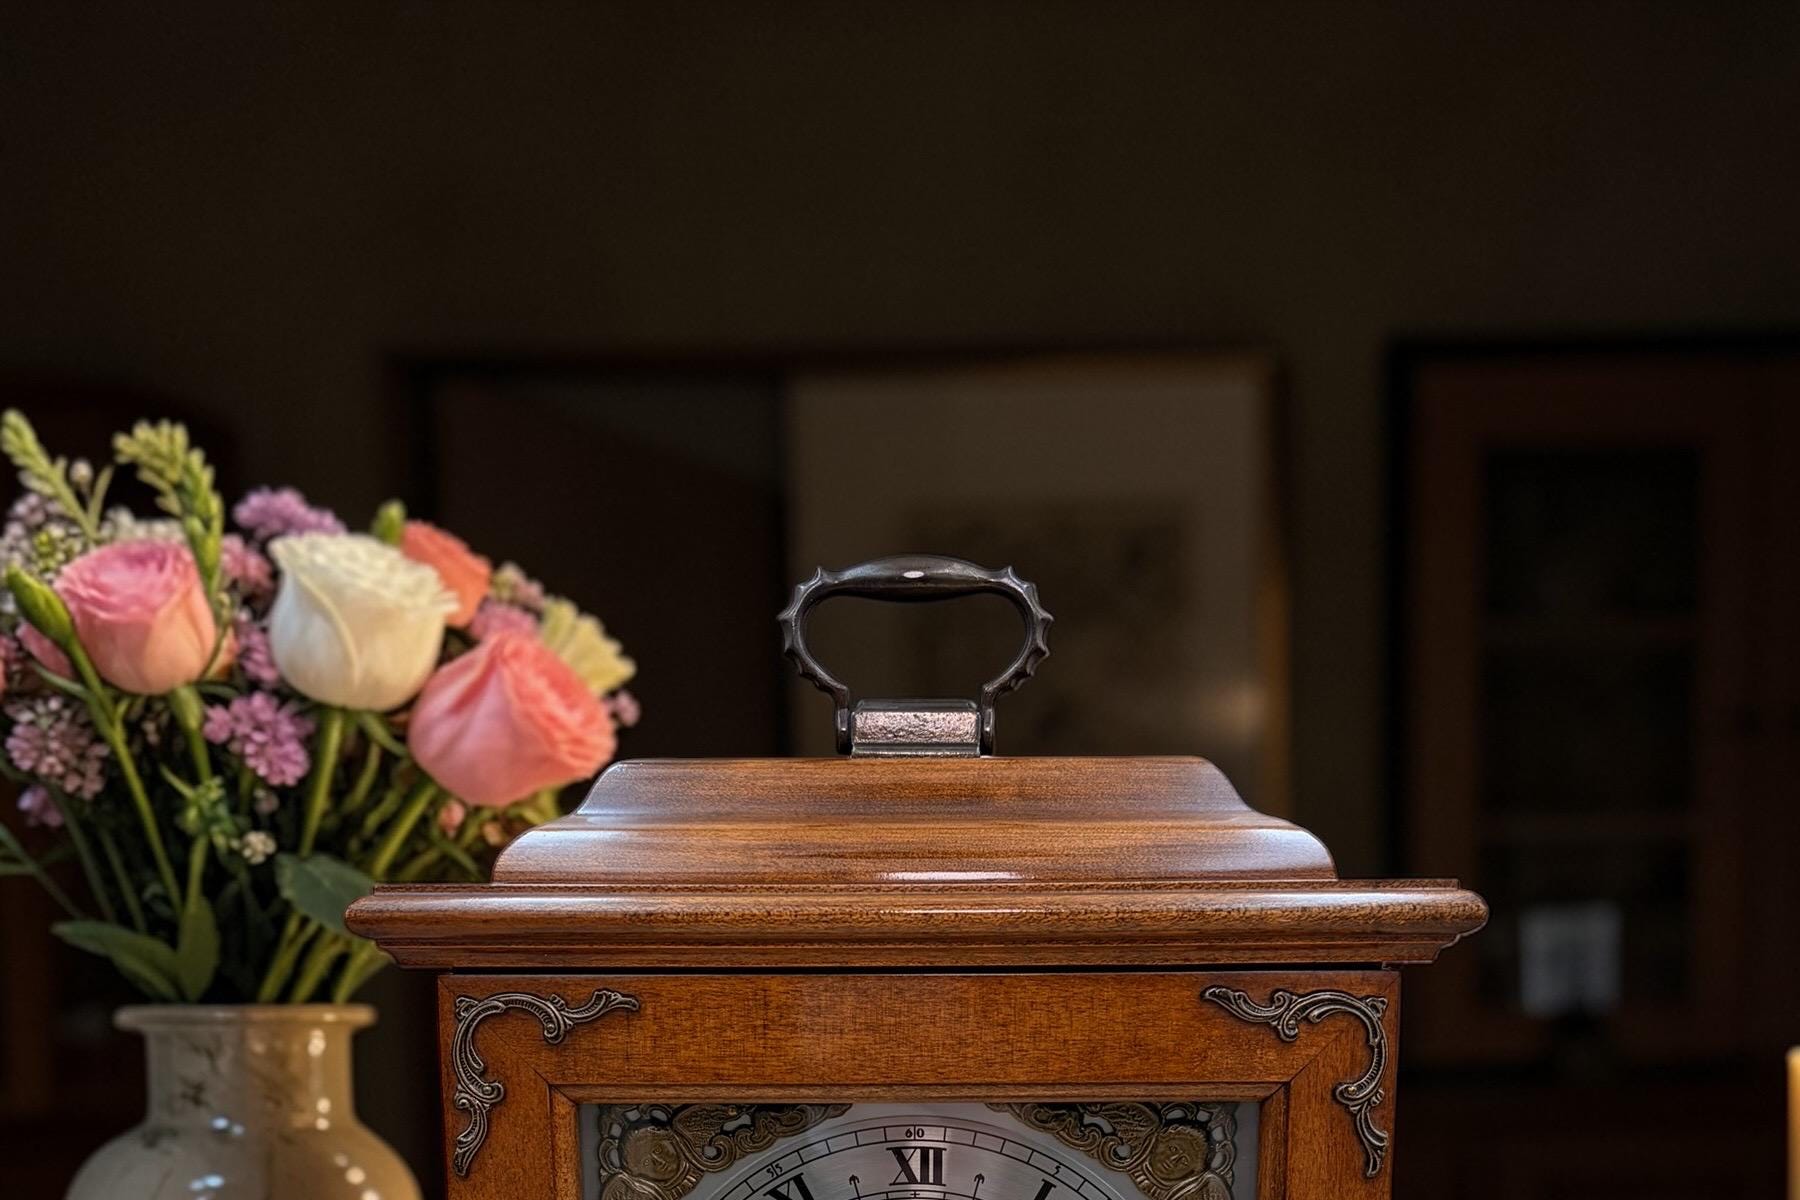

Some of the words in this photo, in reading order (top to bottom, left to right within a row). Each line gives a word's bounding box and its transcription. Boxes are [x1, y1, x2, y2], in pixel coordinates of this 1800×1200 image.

[905, 1128, 925, 1138] 60
[766, 1163, 783, 1178] 55
[886, 1146, 947, 1187] XII
